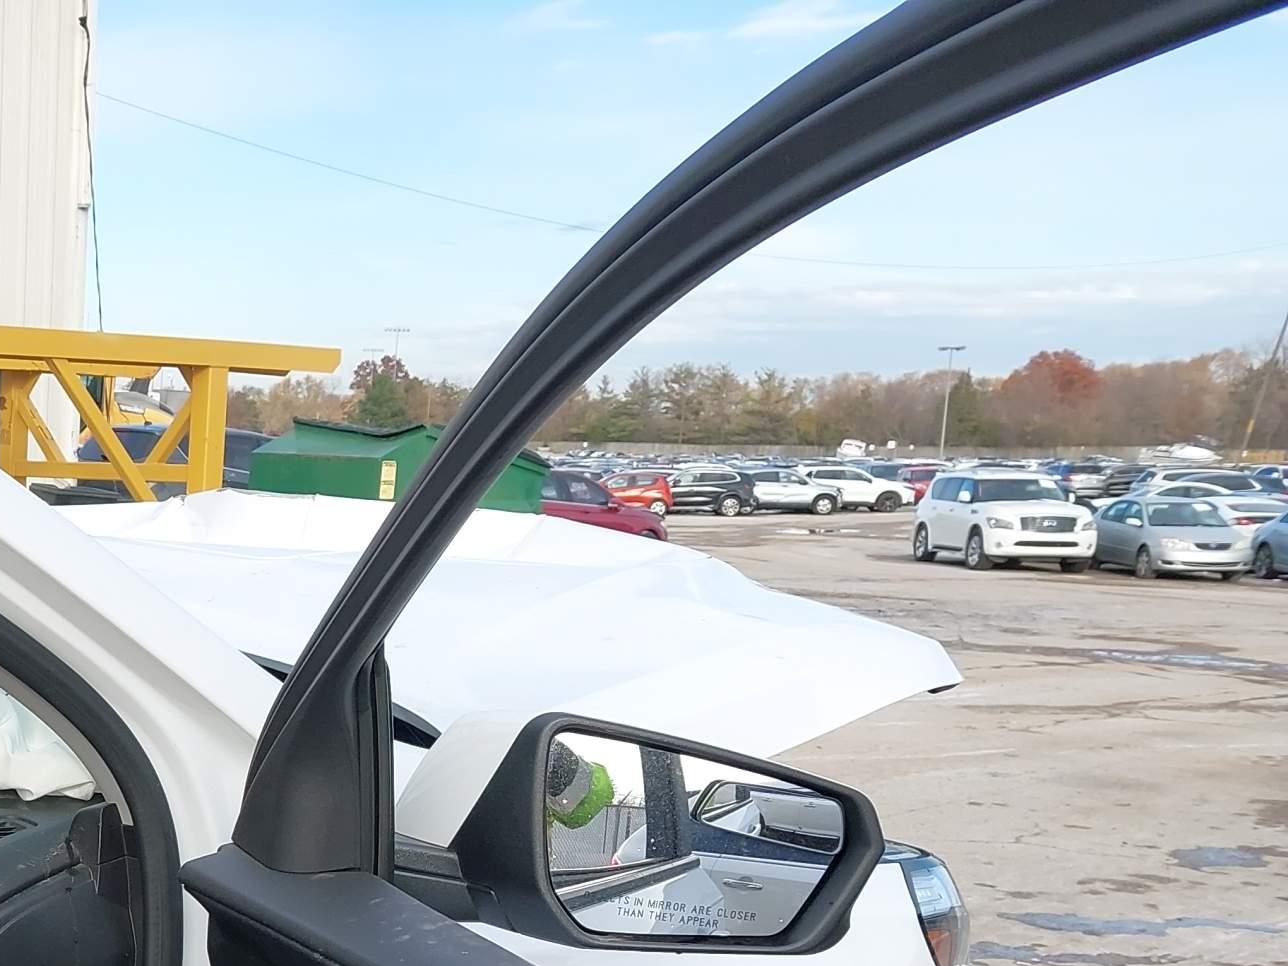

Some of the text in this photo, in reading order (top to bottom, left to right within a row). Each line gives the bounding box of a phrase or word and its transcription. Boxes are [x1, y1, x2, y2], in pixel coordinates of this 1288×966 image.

[617, 907, 719, 928] THAN THEY APPEAR
[633, 897, 644, 907] IN
[647, 898, 686, 913] MIRROR
[690, 905, 713, 916] ARE
[716, 908, 757, 921] CLOSER
